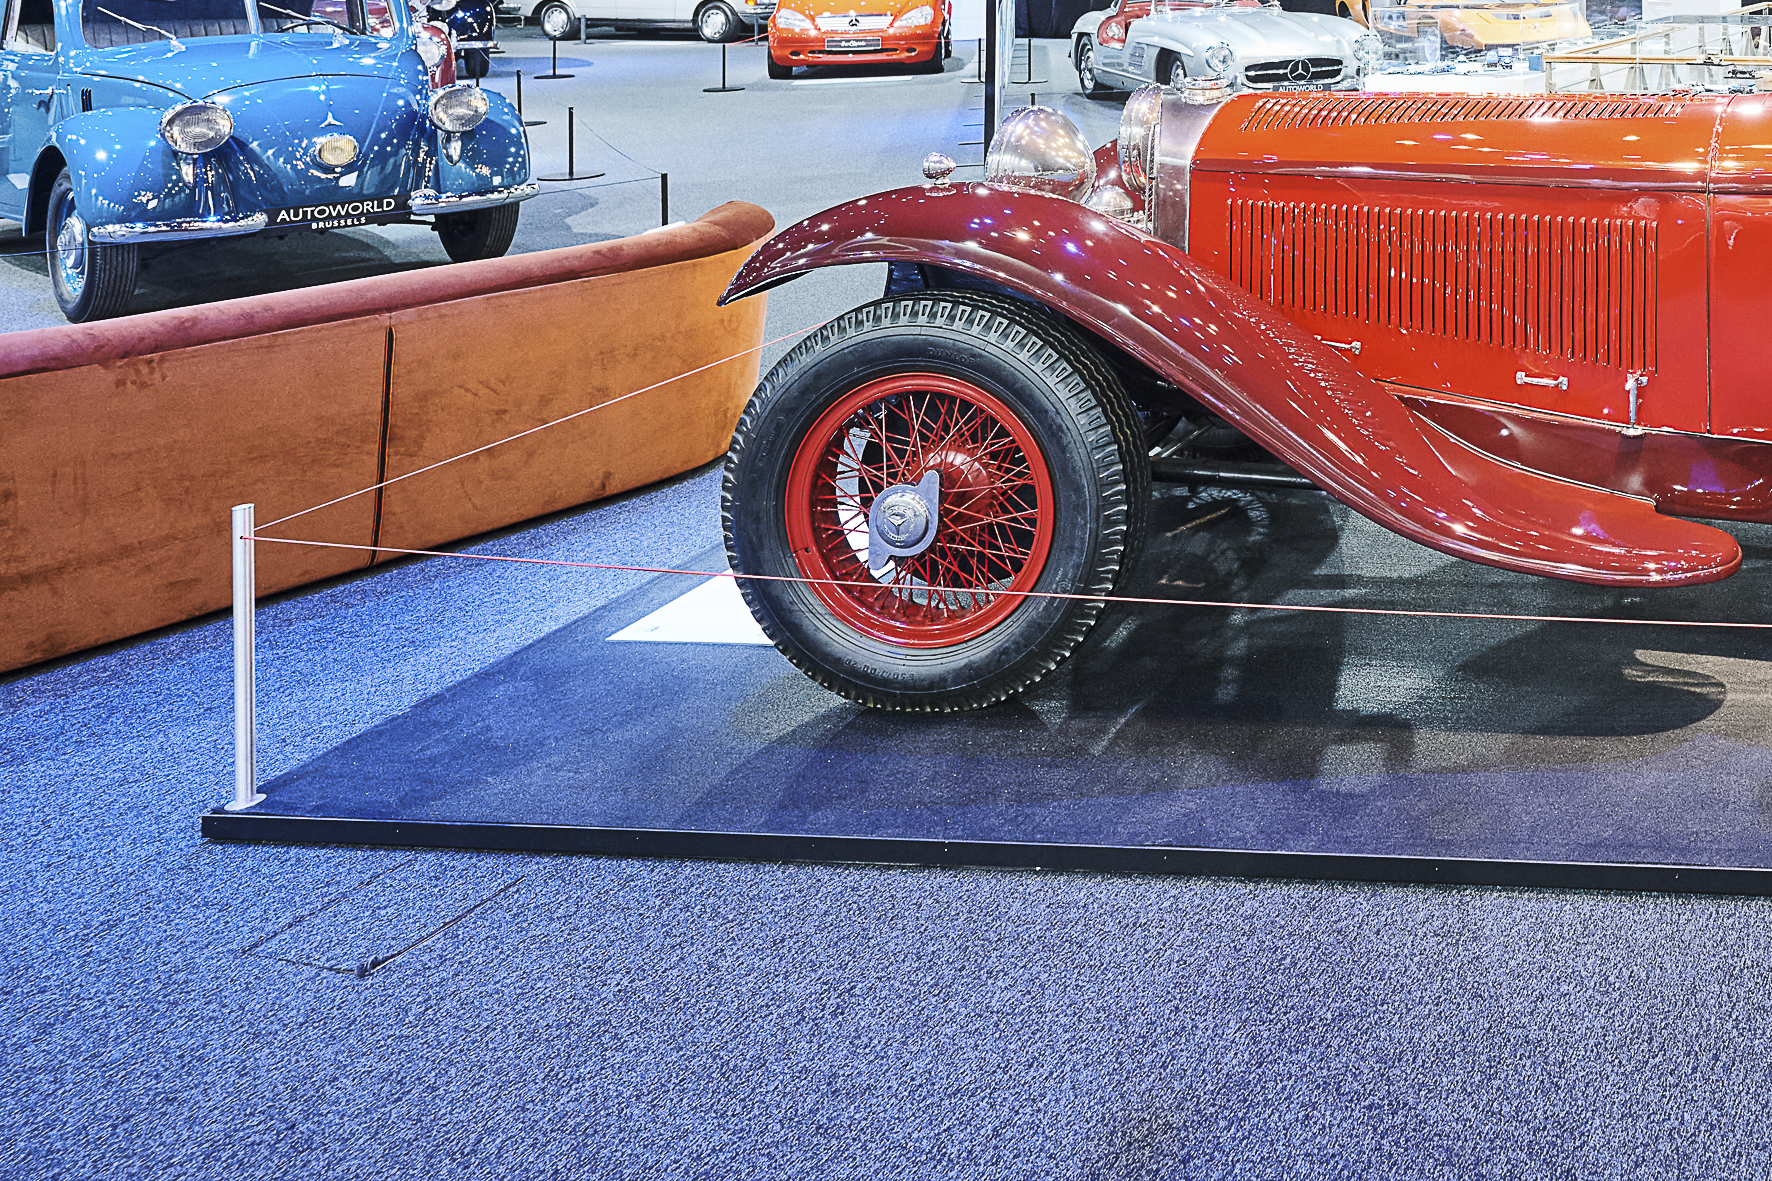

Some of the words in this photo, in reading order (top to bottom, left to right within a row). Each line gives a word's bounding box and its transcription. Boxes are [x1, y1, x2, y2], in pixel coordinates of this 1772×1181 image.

[1278, 83, 1324, 93] AUTOWORLD
[276, 198, 396, 223] AUTOWORLD
[311, 216, 367, 230] BRUSSELS
[927, 346, 975, 365] DUNLOP
